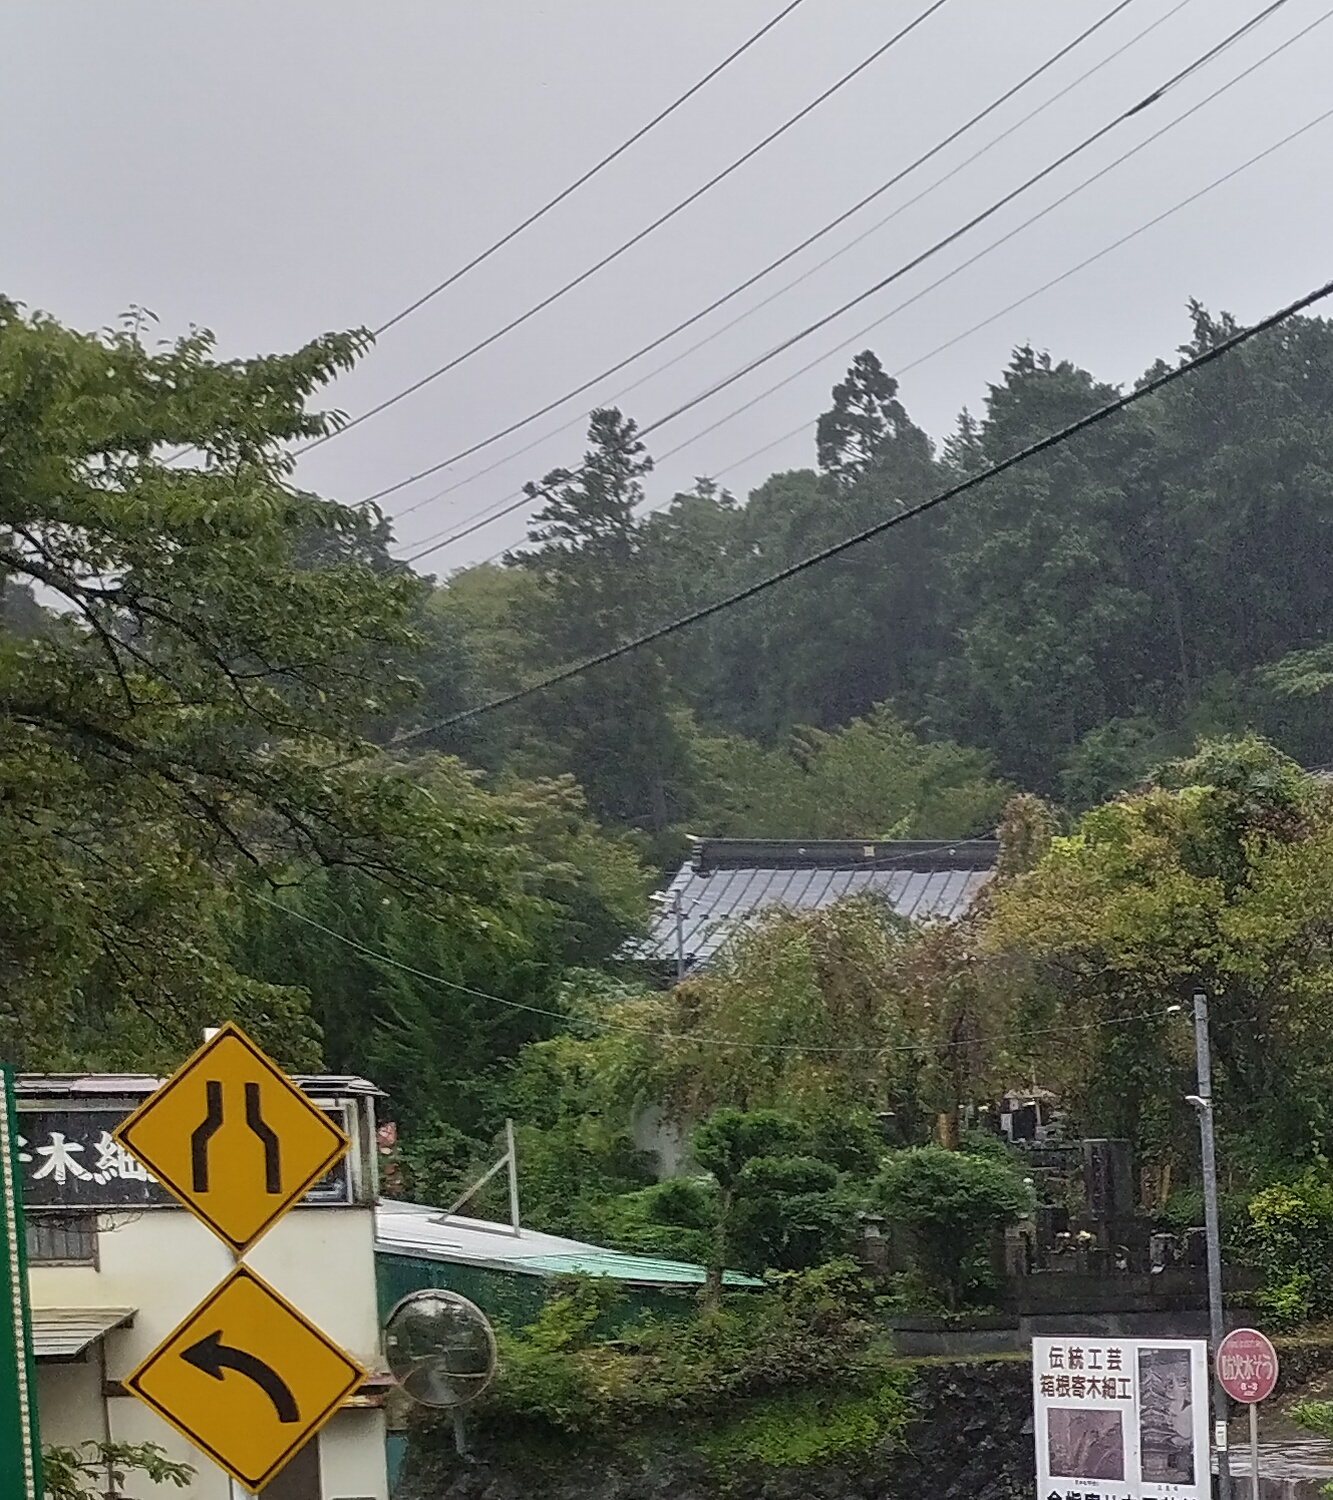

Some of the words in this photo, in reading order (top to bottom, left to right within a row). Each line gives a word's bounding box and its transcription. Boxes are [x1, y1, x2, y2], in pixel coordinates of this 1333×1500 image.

[1048, 1346, 1122, 1371] 伝統工芸
[1221, 1354, 1273, 1380] 防火水そう
[1040, 1373, 1132, 1400] 箱根寄木細工
